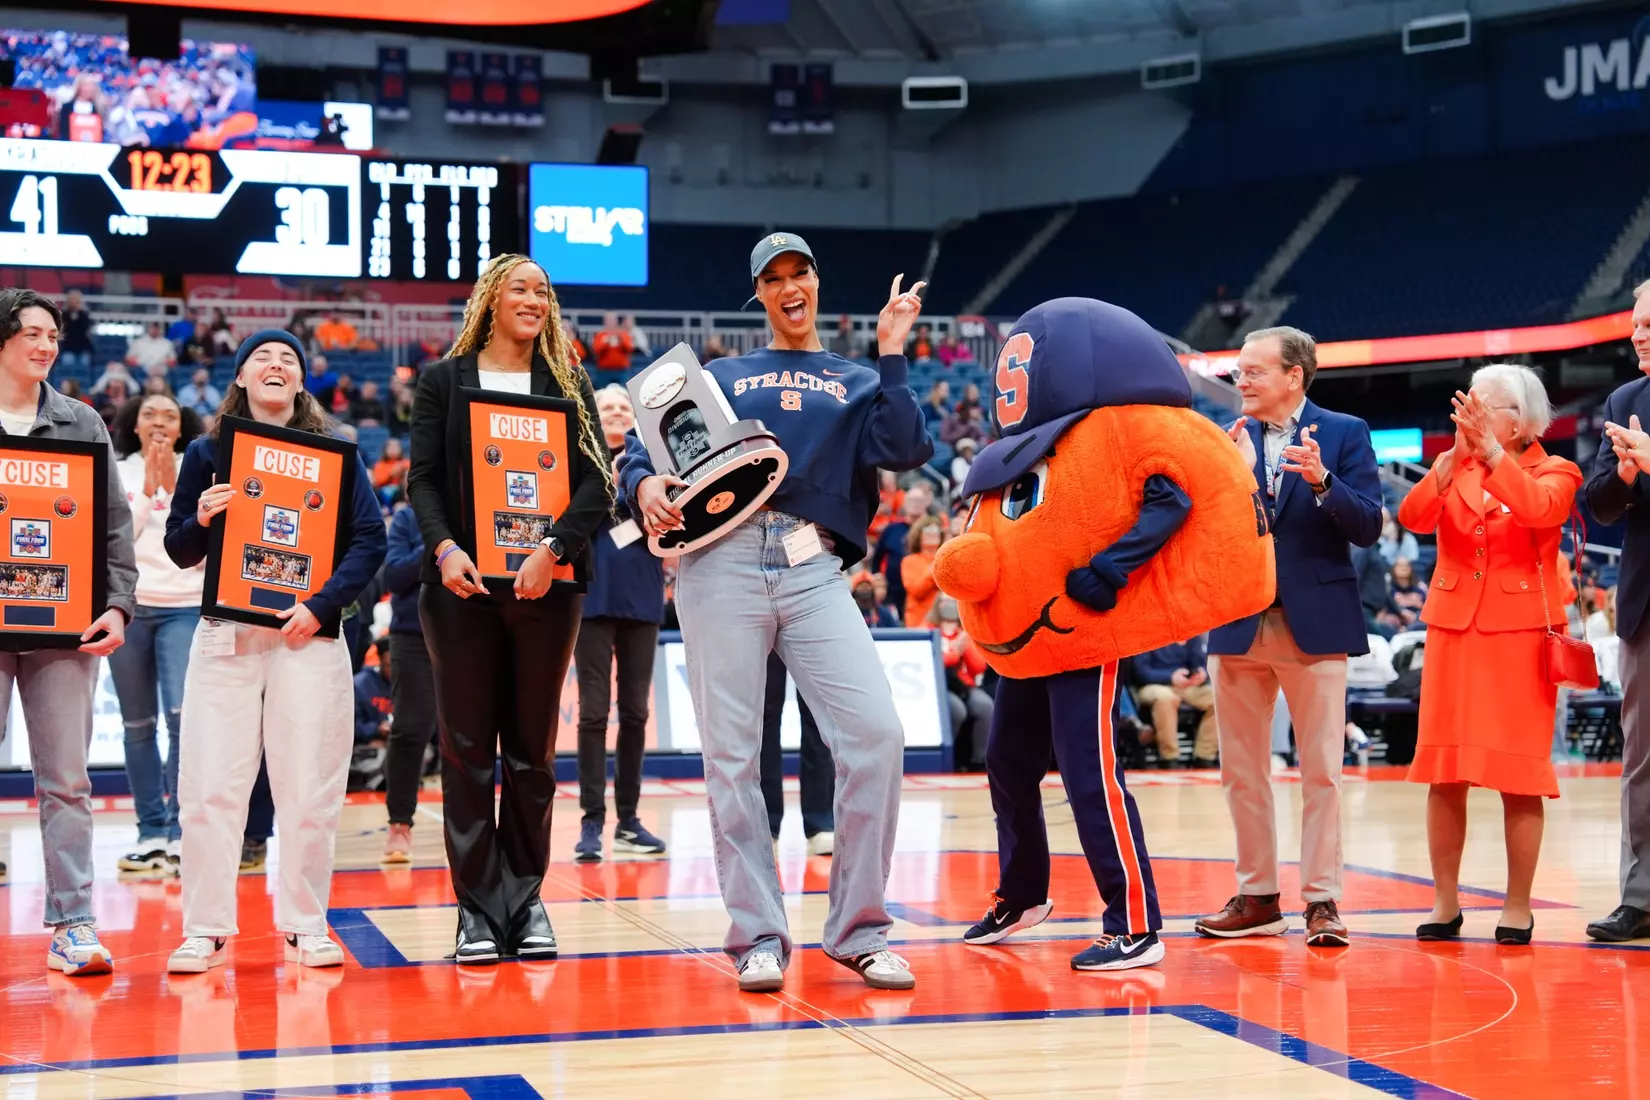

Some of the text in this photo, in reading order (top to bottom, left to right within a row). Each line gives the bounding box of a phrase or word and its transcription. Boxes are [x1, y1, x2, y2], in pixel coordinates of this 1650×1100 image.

[128, 150, 212, 193] 12:23
[10, 174, 58, 234] 41
[274, 186, 329, 244] 30
[769, 234, 787, 247] LA
[734, 371, 850, 404] SYRACUSE
[995, 332, 1035, 429] S
[780, 390, 802, 411] S
[493, 415, 542, 440] 'CUSE
[258, 447, 314, 480] 'CUSE
[692, 448, 736, 478] RUNNER-UP
